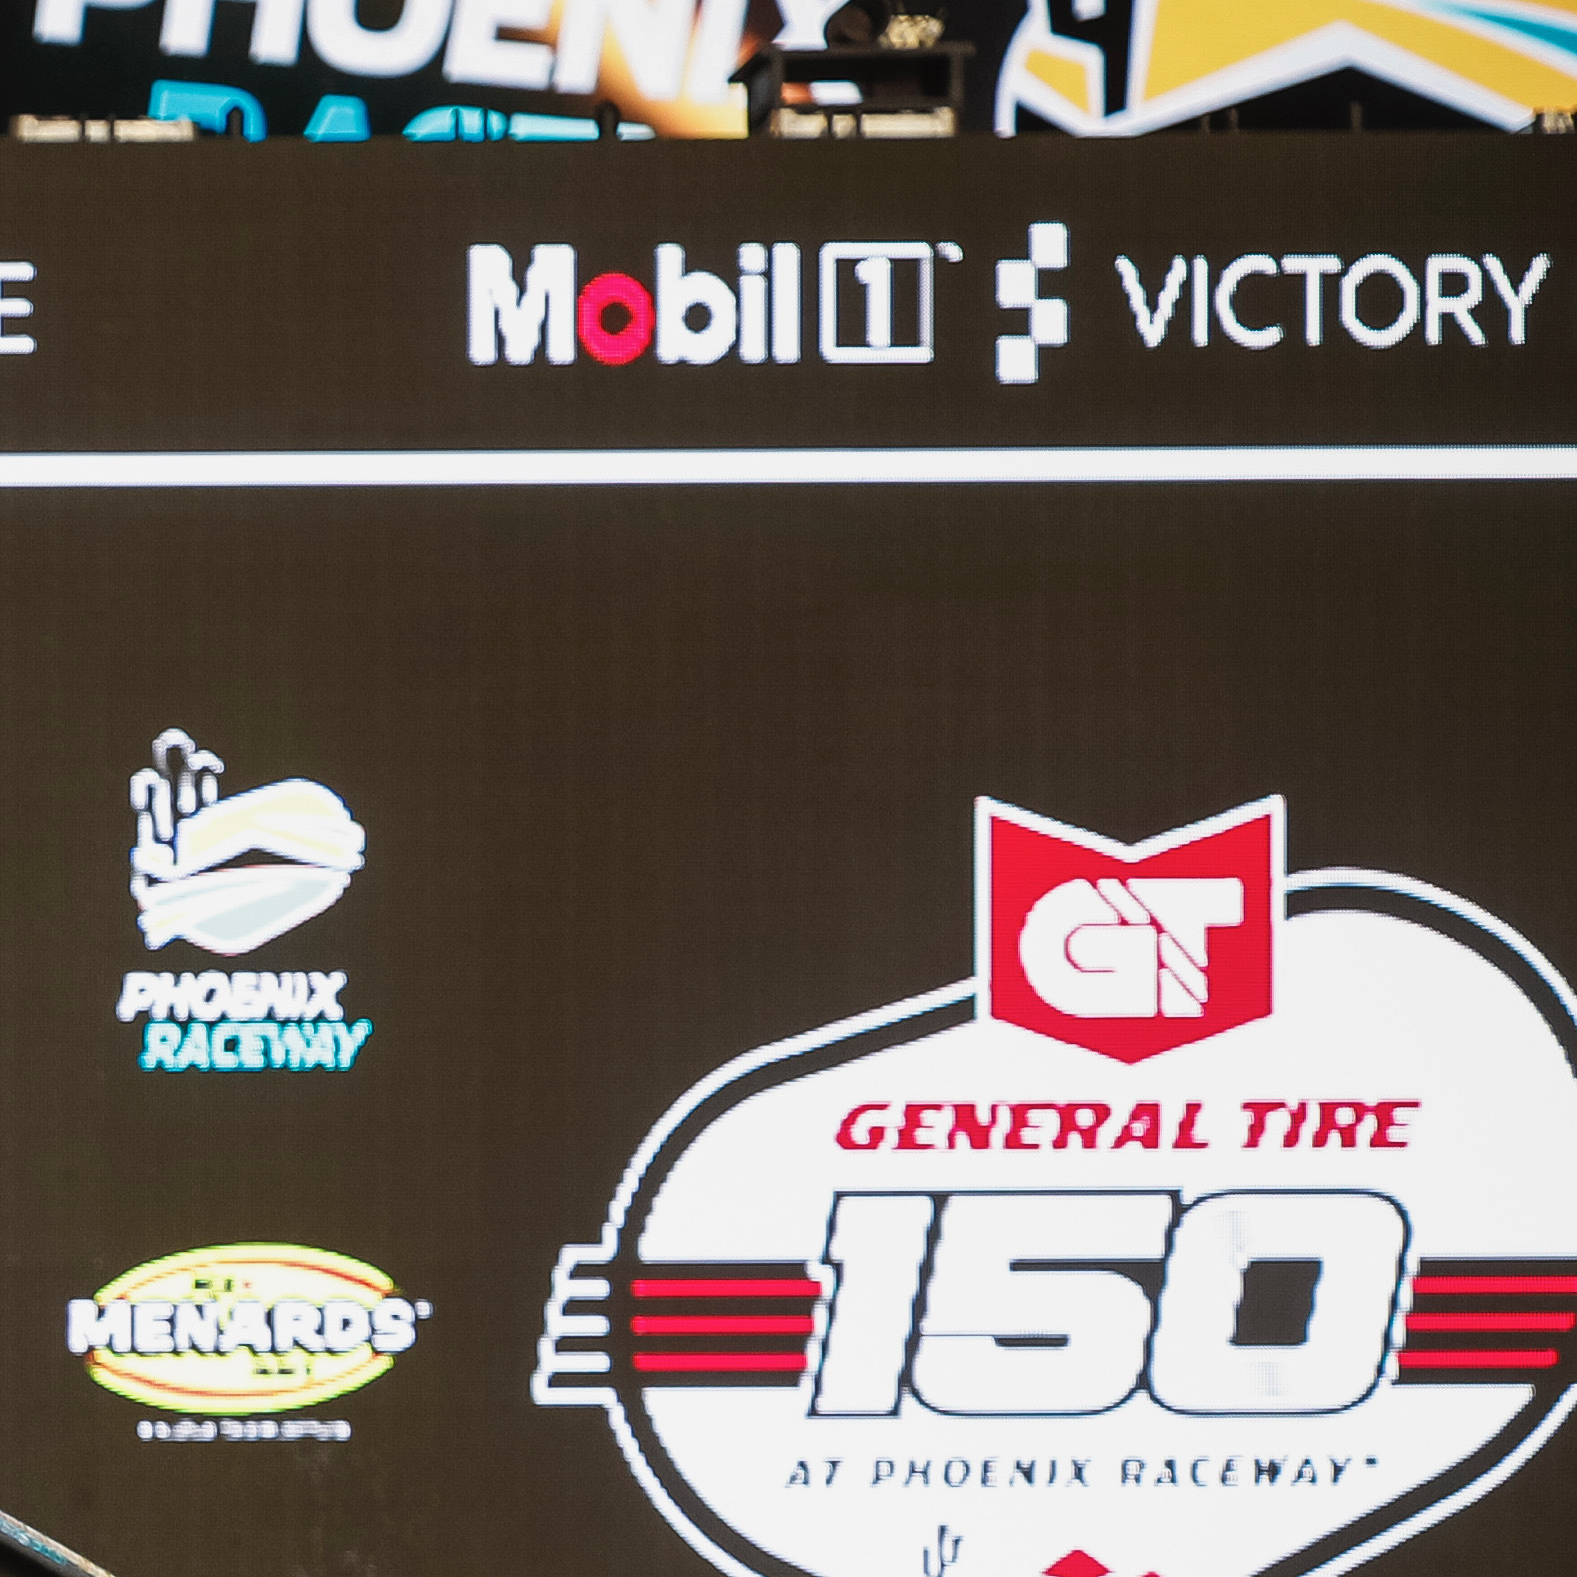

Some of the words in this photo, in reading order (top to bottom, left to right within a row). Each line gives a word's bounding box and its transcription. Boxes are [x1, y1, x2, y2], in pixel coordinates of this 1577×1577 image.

[467, 242, 802, 366] Mobil
[1115, 252, 1552, 350] VICTORY
[1019, 877, 1243, 1019] GT
[117, 970, 348, 1022] PHOENIX
[139, 1019, 374, 1072] RACEWAY
[834, 1099, 1211, 1152] GENERAL
[1240, 1099, 1422, 1152] TIRE
[66, 1298, 416, 1356] MENARDS
[807, 1188, 1413, 1419] 150
[785, 1456, 845, 1489] AT
[870, 1456, 1092, 1489] PHOENIX
[1118, 1455, 1354, 1489] RACEWAY
